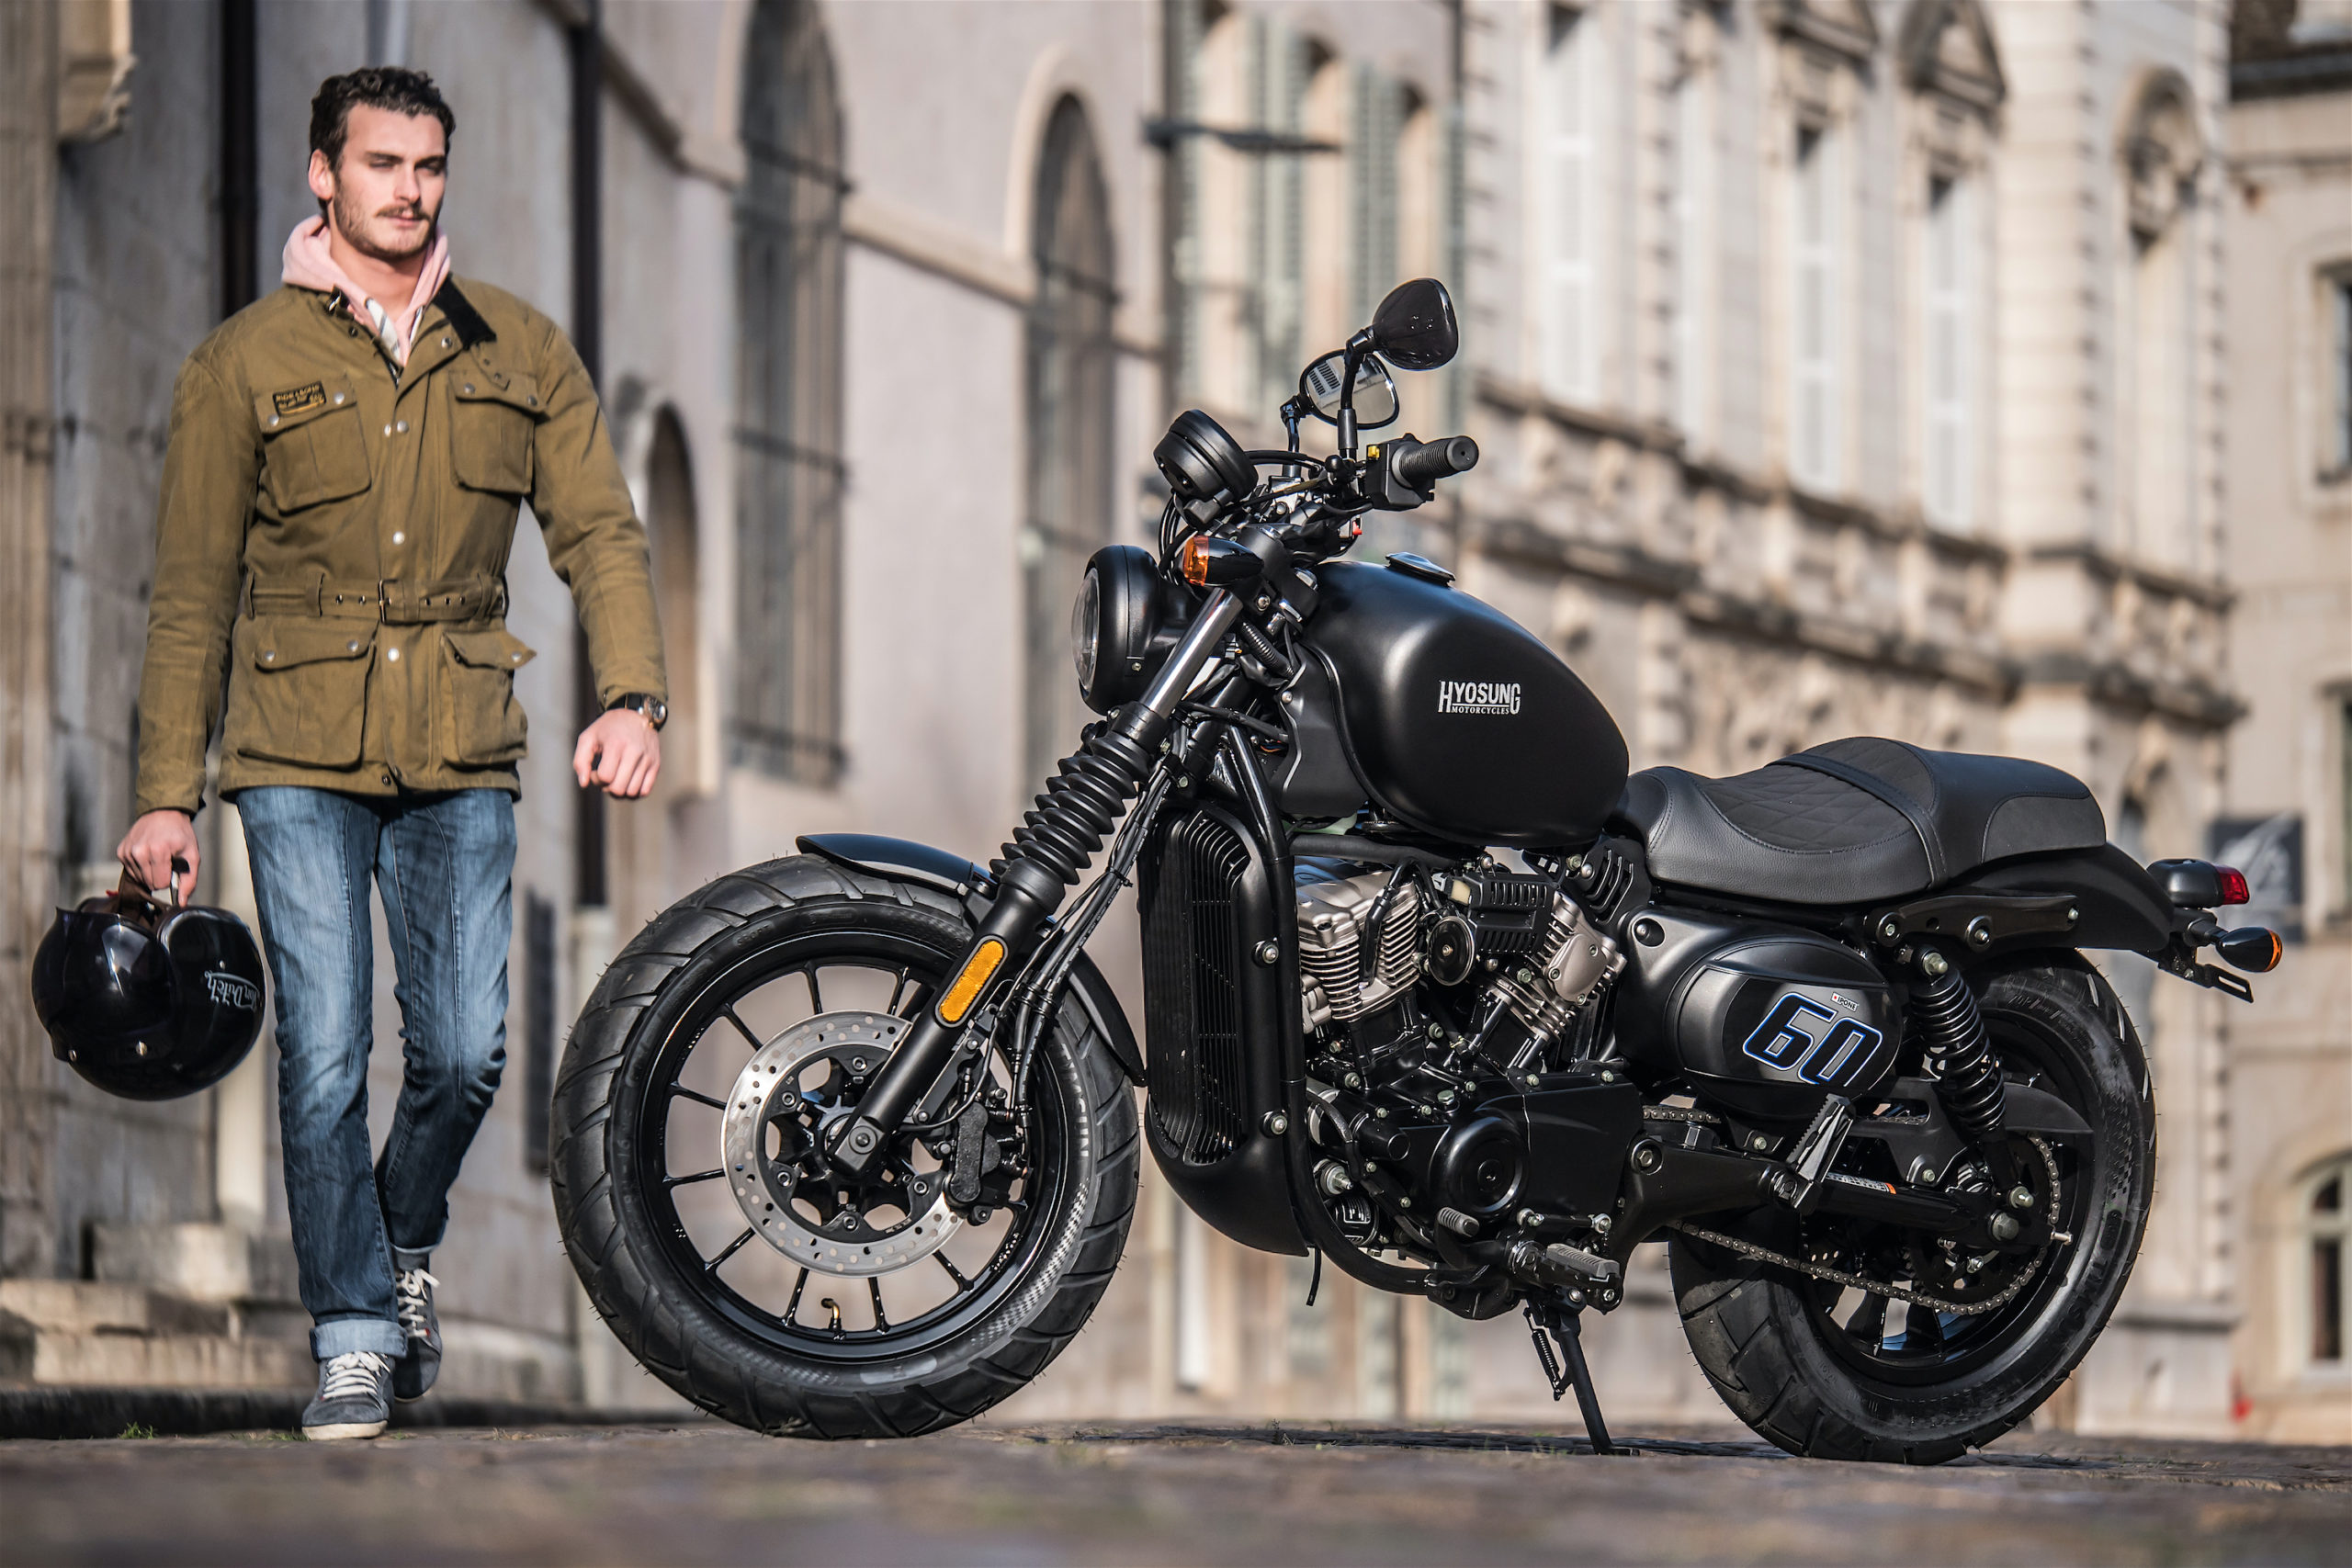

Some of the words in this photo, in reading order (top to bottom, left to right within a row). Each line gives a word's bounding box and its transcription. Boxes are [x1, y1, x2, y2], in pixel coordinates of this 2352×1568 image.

[1438, 681, 1521, 715] HYOSUNG
[1452, 705, 1510, 715] MOTORCYCLES
[205, 972, 243, 1008] Dutch
[1838, 996, 1856, 1010] IPONE
[1743, 991, 1883, 1088] 60
